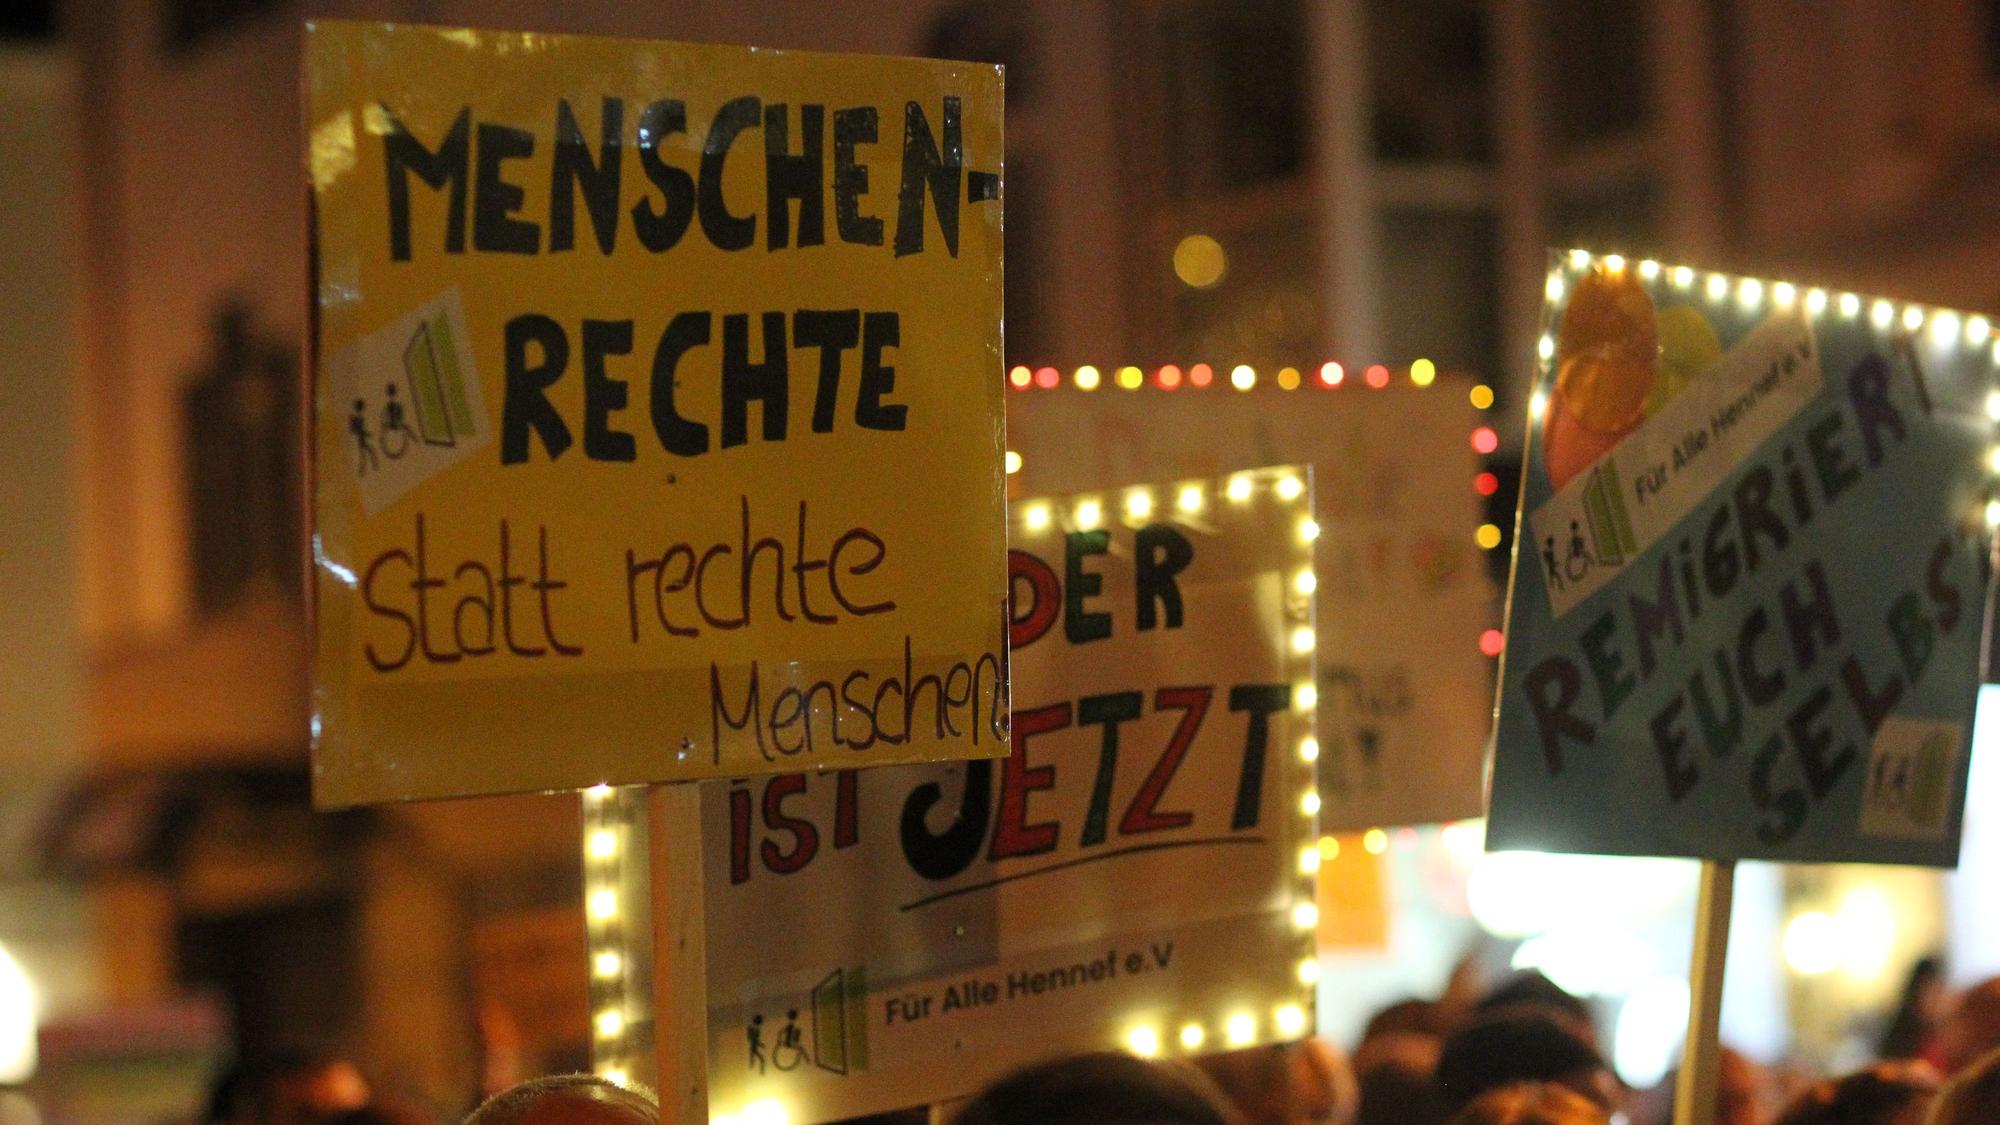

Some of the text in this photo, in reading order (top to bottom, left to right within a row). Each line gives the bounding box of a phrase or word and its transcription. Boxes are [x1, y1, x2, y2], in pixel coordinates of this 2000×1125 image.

[382, 95, 999, 262] MENSCHEN-
[500, 309, 908, 466] RECHTE
[626, 495, 897, 643] rechte
[1647, 558, 1844, 806] EUCH
[900, 684, 1291, 881] JETZT
[884, 992, 933, 1026] Für
[942, 979, 999, 1015] Alle
[1006, 949, 1119, 1000] Hennef
